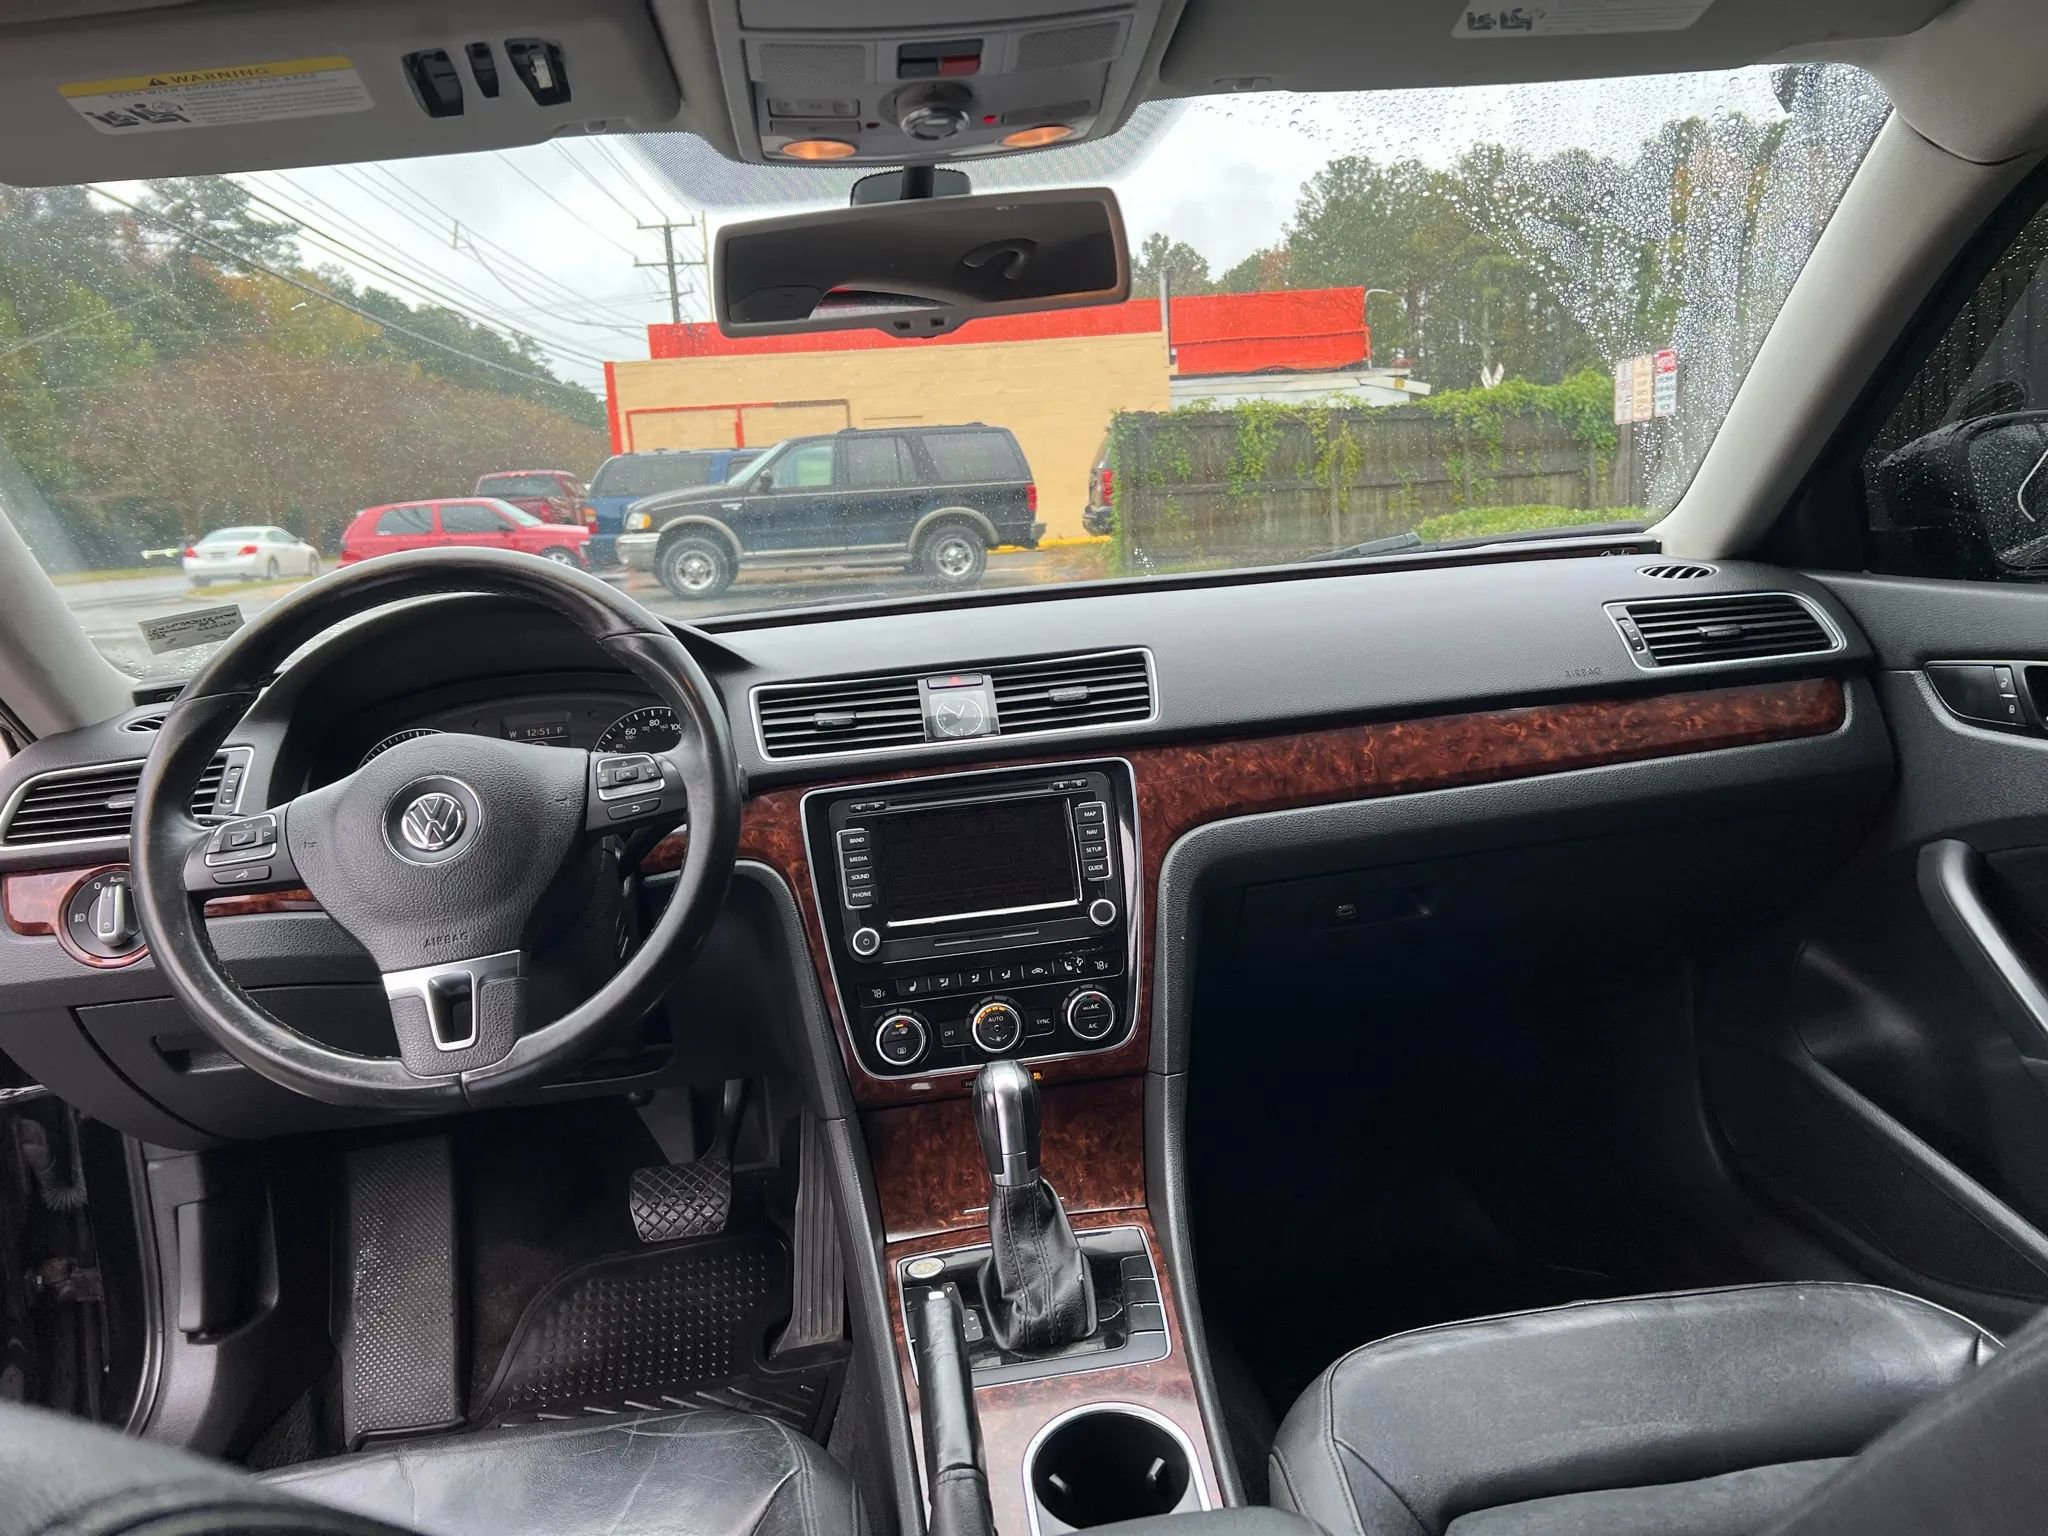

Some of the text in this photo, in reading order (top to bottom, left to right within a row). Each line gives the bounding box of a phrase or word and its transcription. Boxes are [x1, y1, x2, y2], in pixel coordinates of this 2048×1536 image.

[169, 66, 270, 84] WARNING
[648, 719, 660, 727] 80
[526, 727, 550, 737] 12:51
[849, 855, 868, 863] MEDIA
[1088, 864, 1104, 872] GUIDE
[850, 873, 870, 881] SOUND
[852, 891, 872, 899] PHONE
[424, 931, 469, 948] AIRBAG
[988, 1015, 1004, 1023] AUTO
[1036, 1017, 1051, 1025] SYNC
